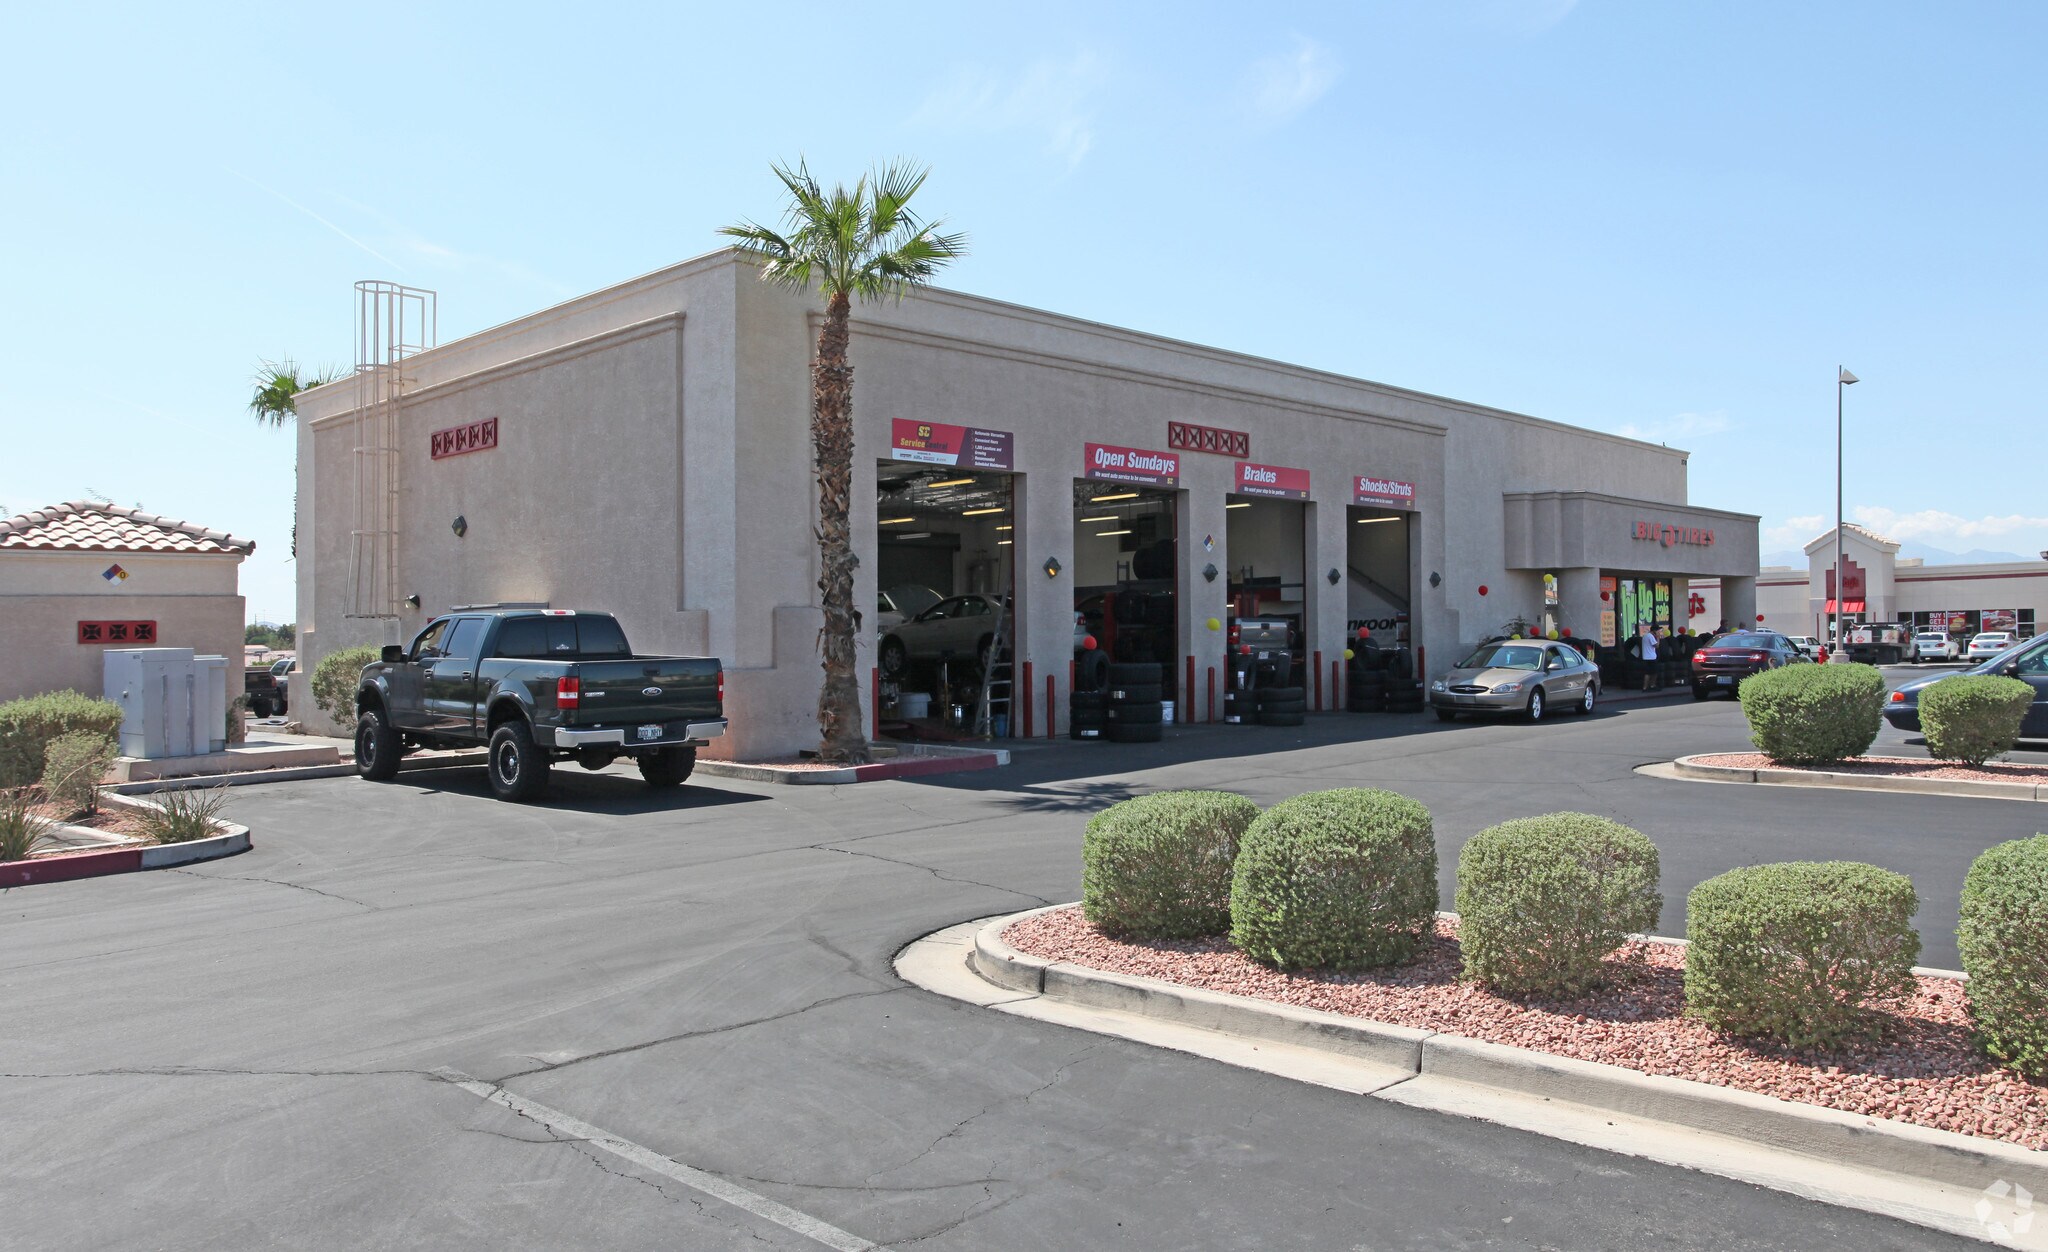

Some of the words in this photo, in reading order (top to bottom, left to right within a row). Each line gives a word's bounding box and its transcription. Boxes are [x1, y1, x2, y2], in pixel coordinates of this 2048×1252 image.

[1095, 448, 1125, 468] Open
[1128, 452, 1175, 474] Sundays
[1244, 466, 1276, 483] Brakes
[1360, 478, 1412, 496] Shocks/Struts
[1633, 521, 1662, 541] BIG
[1677, 526, 1715, 546] TIRES
[1655, 582, 1669, 602] tire
[1656, 602, 1669, 622] sale
